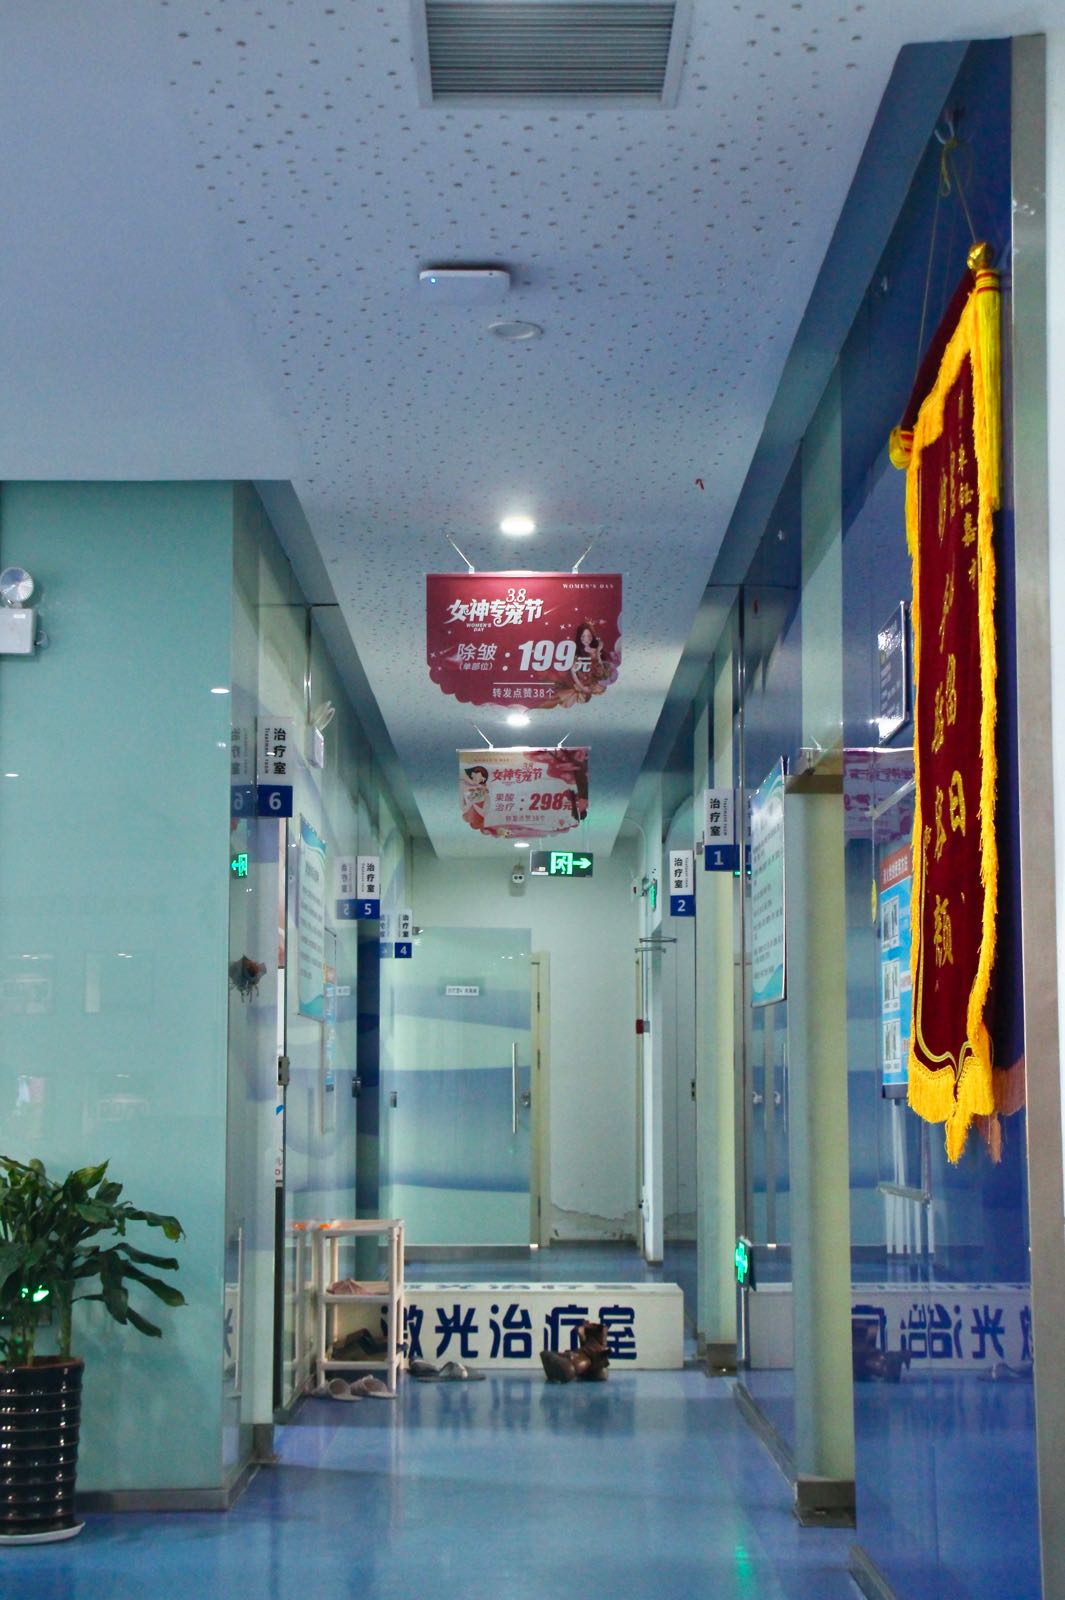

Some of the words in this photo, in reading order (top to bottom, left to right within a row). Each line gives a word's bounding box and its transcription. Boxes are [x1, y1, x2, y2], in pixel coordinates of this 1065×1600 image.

[443, 599, 544, 627] 女神专宠节
[492, 687, 556, 699] 转发点赞38个
[273, 728, 287, 775] 治疗室
[268, 792, 282, 810] 6
[710, 798, 721, 836] 治疗室
[714, 851, 724, 866] 1
[367, 863, 376, 893] 治疗室
[674, 857, 683, 889] 治疗室
[364, 903, 372, 915] 5
[677, 900, 686, 912] 2
[400, 946, 408, 955] 4
